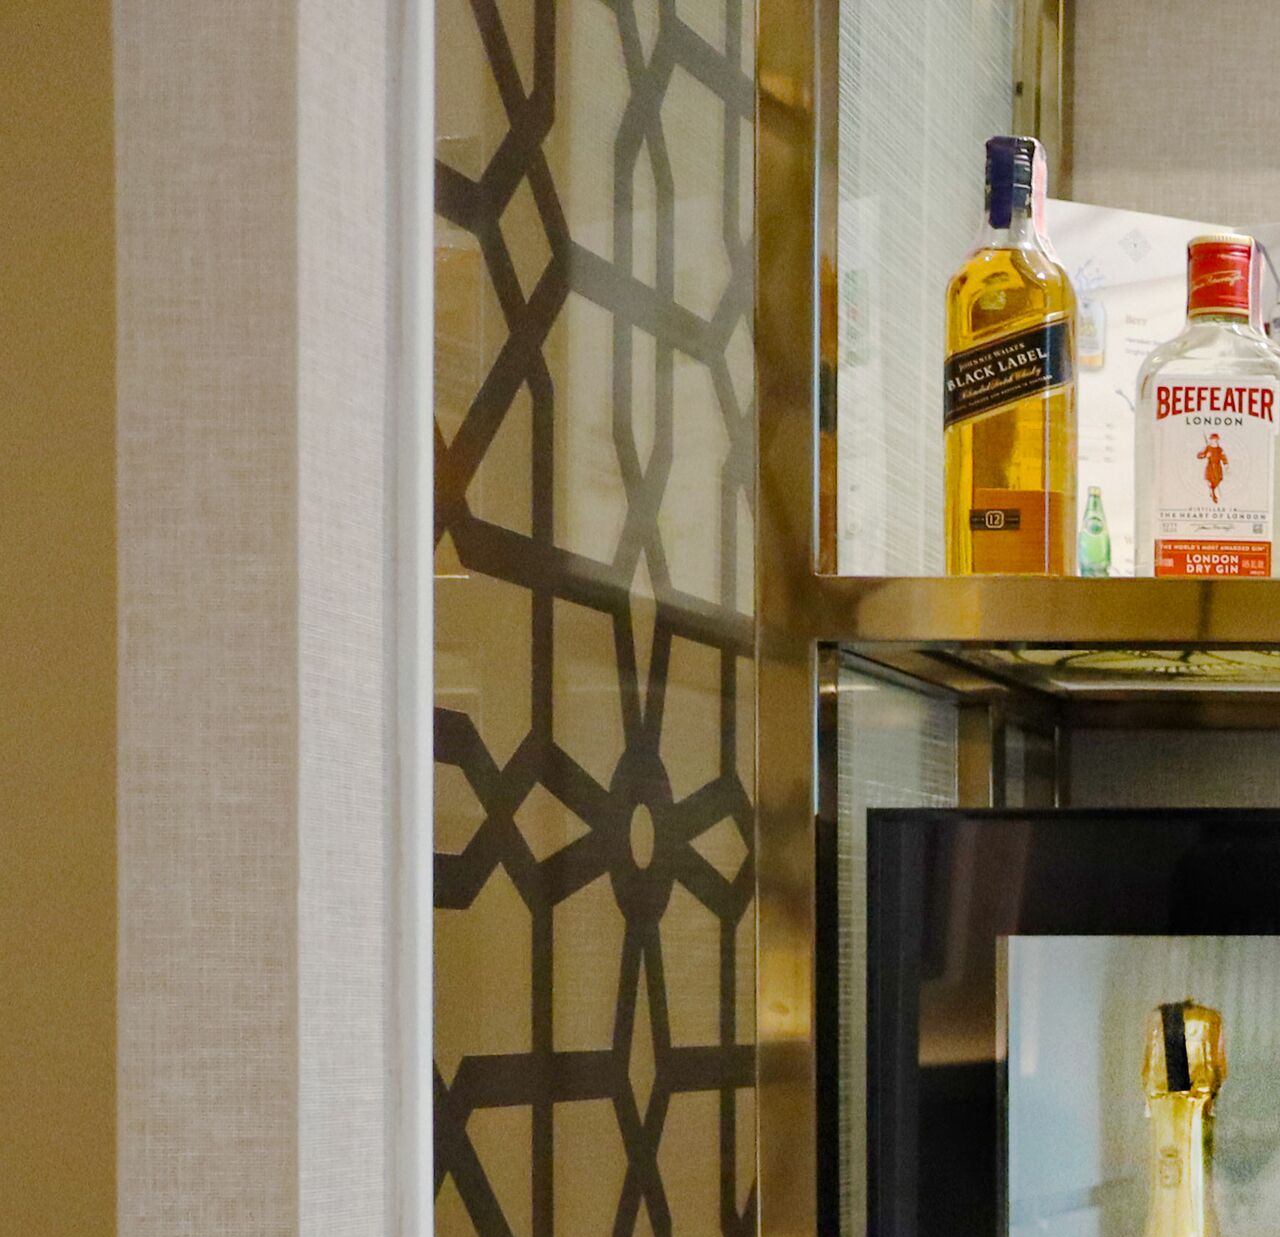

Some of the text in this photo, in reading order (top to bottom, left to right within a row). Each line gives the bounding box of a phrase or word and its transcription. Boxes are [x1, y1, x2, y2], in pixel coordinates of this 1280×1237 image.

[946, 364, 996, 392] BLACK
[997, 347, 1048, 373] LABEL
[1156, 386, 1275, 423] BEEFEATER
[1185, 416, 1243, 426] LONDON
[989, 514, 1001, 525] 12
[1186, 553, 1239, 564] LONDON
[1186, 564, 1212, 574] DRY
[1215, 564, 1239, 574] GIN
